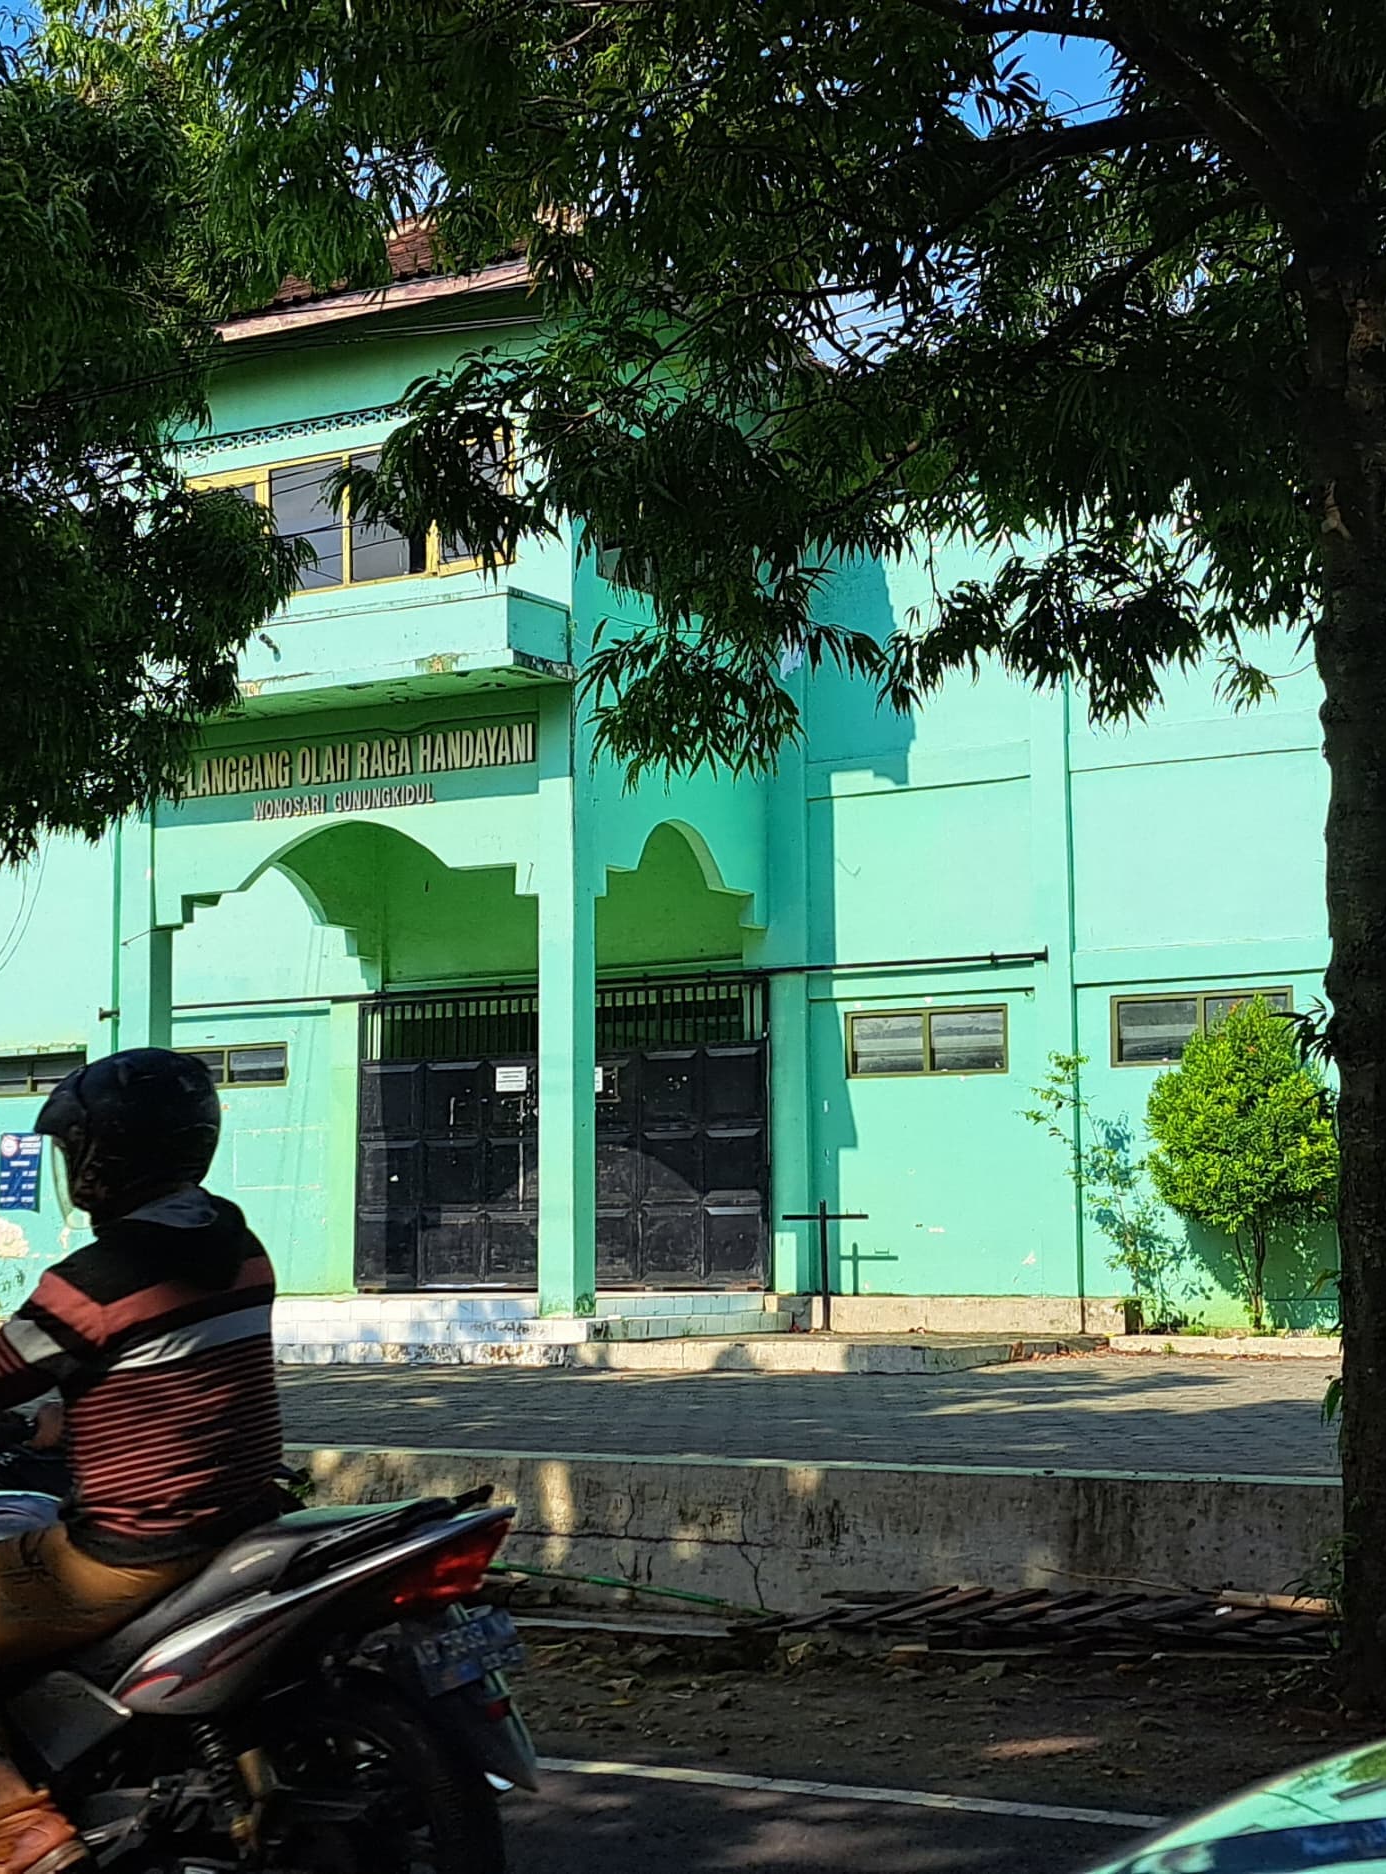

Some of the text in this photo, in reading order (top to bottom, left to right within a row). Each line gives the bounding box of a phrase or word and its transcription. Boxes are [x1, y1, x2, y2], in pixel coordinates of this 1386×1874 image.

[297, 744, 350, 785] OLAH
[356, 737, 412, 779] RAGA
[419, 723, 536, 773] HANDAYANI
[253, 783, 434, 821] WONOSARI GUNUNGKIDUL
